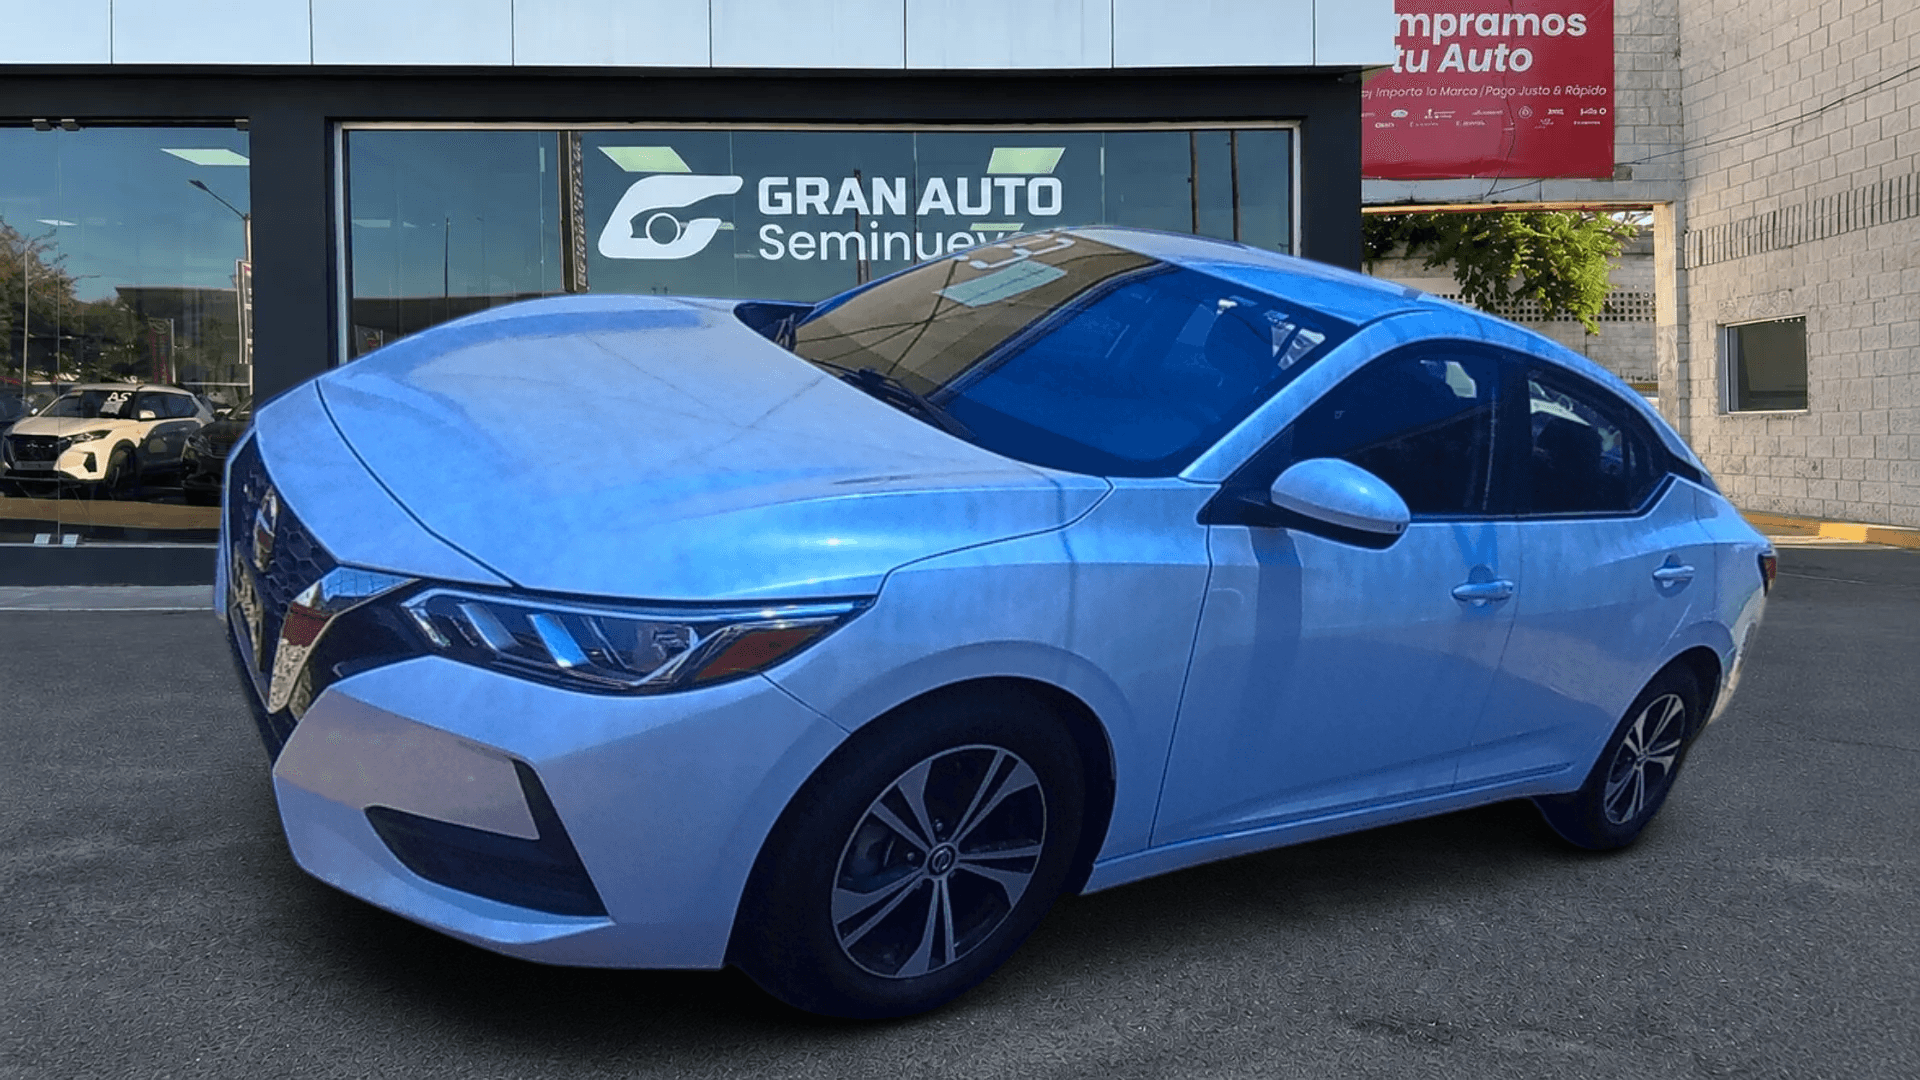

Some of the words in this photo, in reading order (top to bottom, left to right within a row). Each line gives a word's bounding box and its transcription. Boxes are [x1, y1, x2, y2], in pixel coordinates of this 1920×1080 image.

[1392, 44, 1430, 73] tu
[1437, 43, 1533, 73] Auto
[1376, 87, 1424, 99] Importa
[1426, 86, 1437, 97] la
[1440, 86, 1478, 97] Marca
[1518, 86, 1551, 96] Justo
[1553, 86, 1561, 95] &
[1565, 84, 1607, 98] Rápido
[758, 176, 906, 215] GRAN
[917, 176, 1062, 215] AUTO
